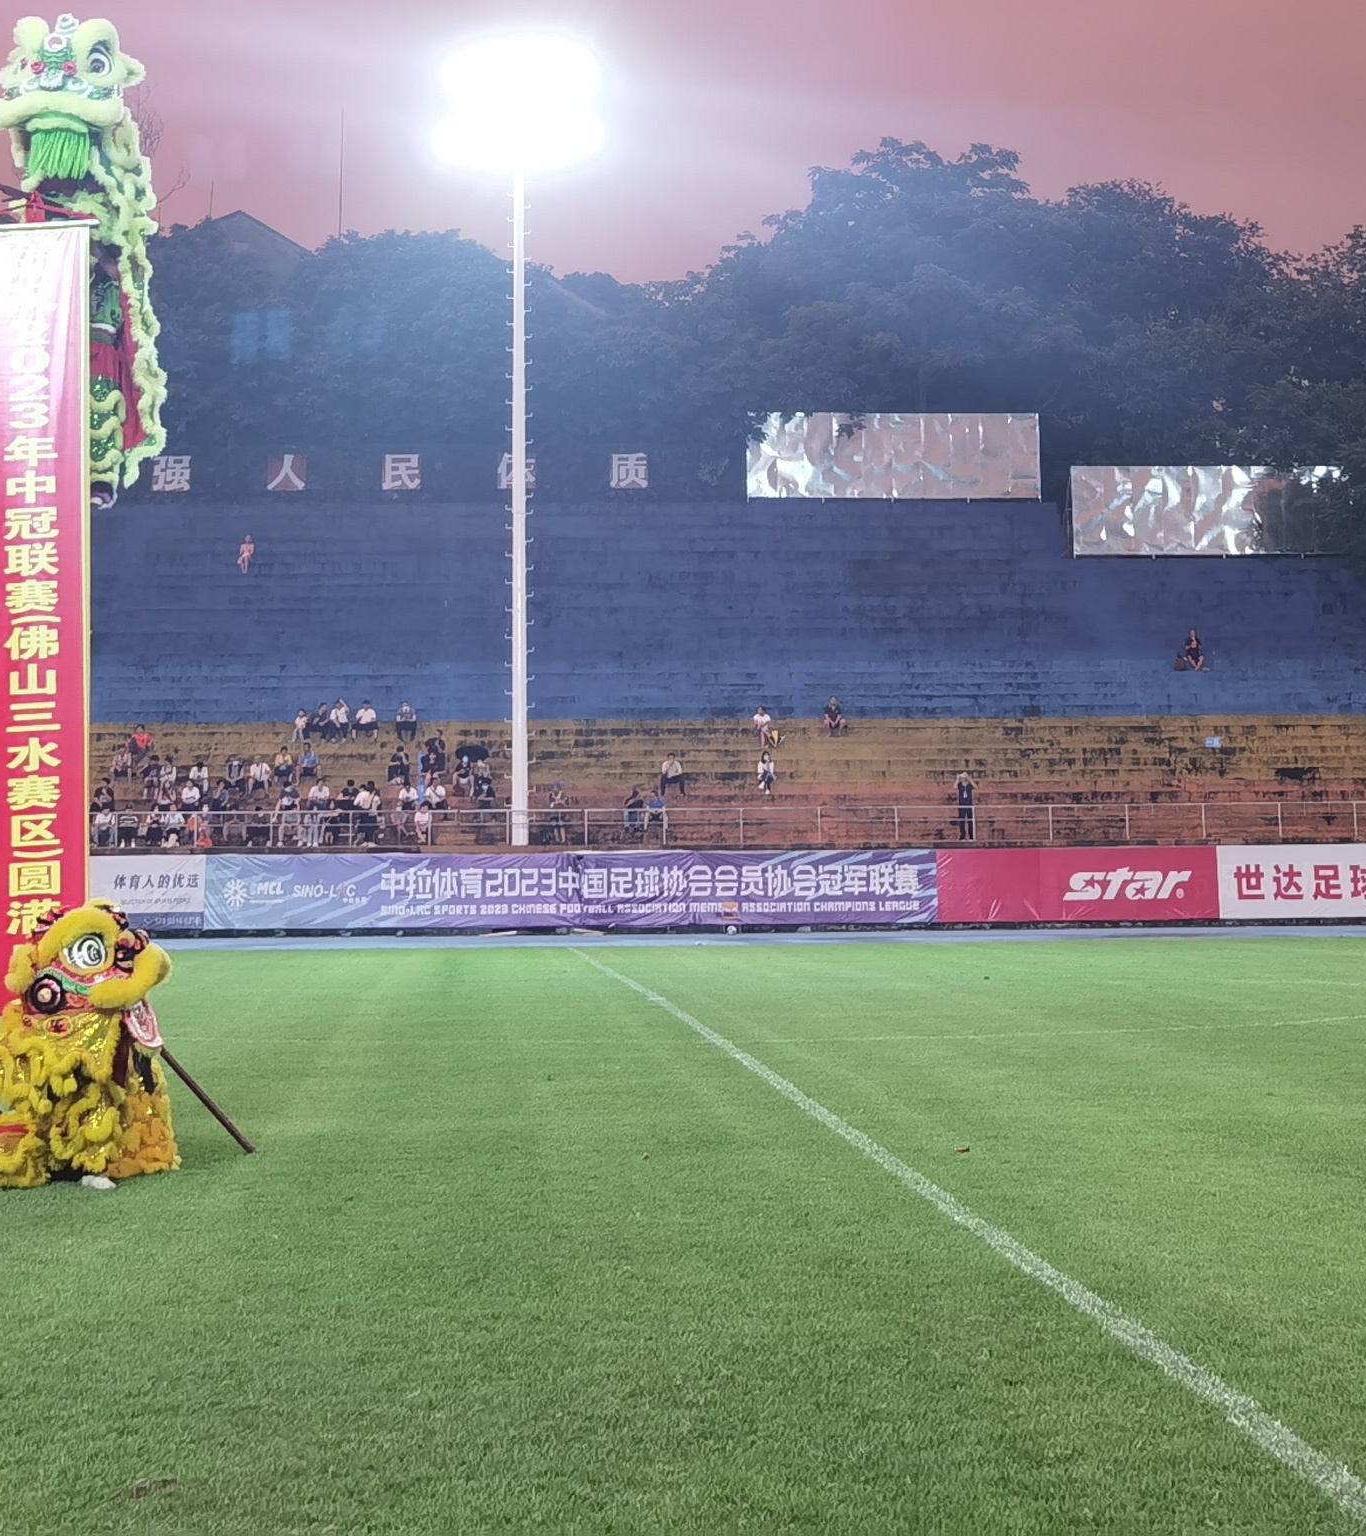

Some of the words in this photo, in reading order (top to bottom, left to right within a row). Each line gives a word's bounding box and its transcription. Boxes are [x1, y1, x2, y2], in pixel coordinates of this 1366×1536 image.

[113, 873, 199, 890] 体育人的优选
[381, 863, 919, 899] 中拉体育2023中国足球协会会员协会冠军联赛
[434, 904, 477, 915] SPORTS
[480, 904, 508, 915] 2023
[511, 903, 557, 915] CHINESE
[617, 902, 686, 915] ASSOCIATION
[742, 901, 811, 913] ASSOCIATION
[813, 901, 876, 912] CHAMPIONS
[879, 900, 920, 912] LEAGUE
